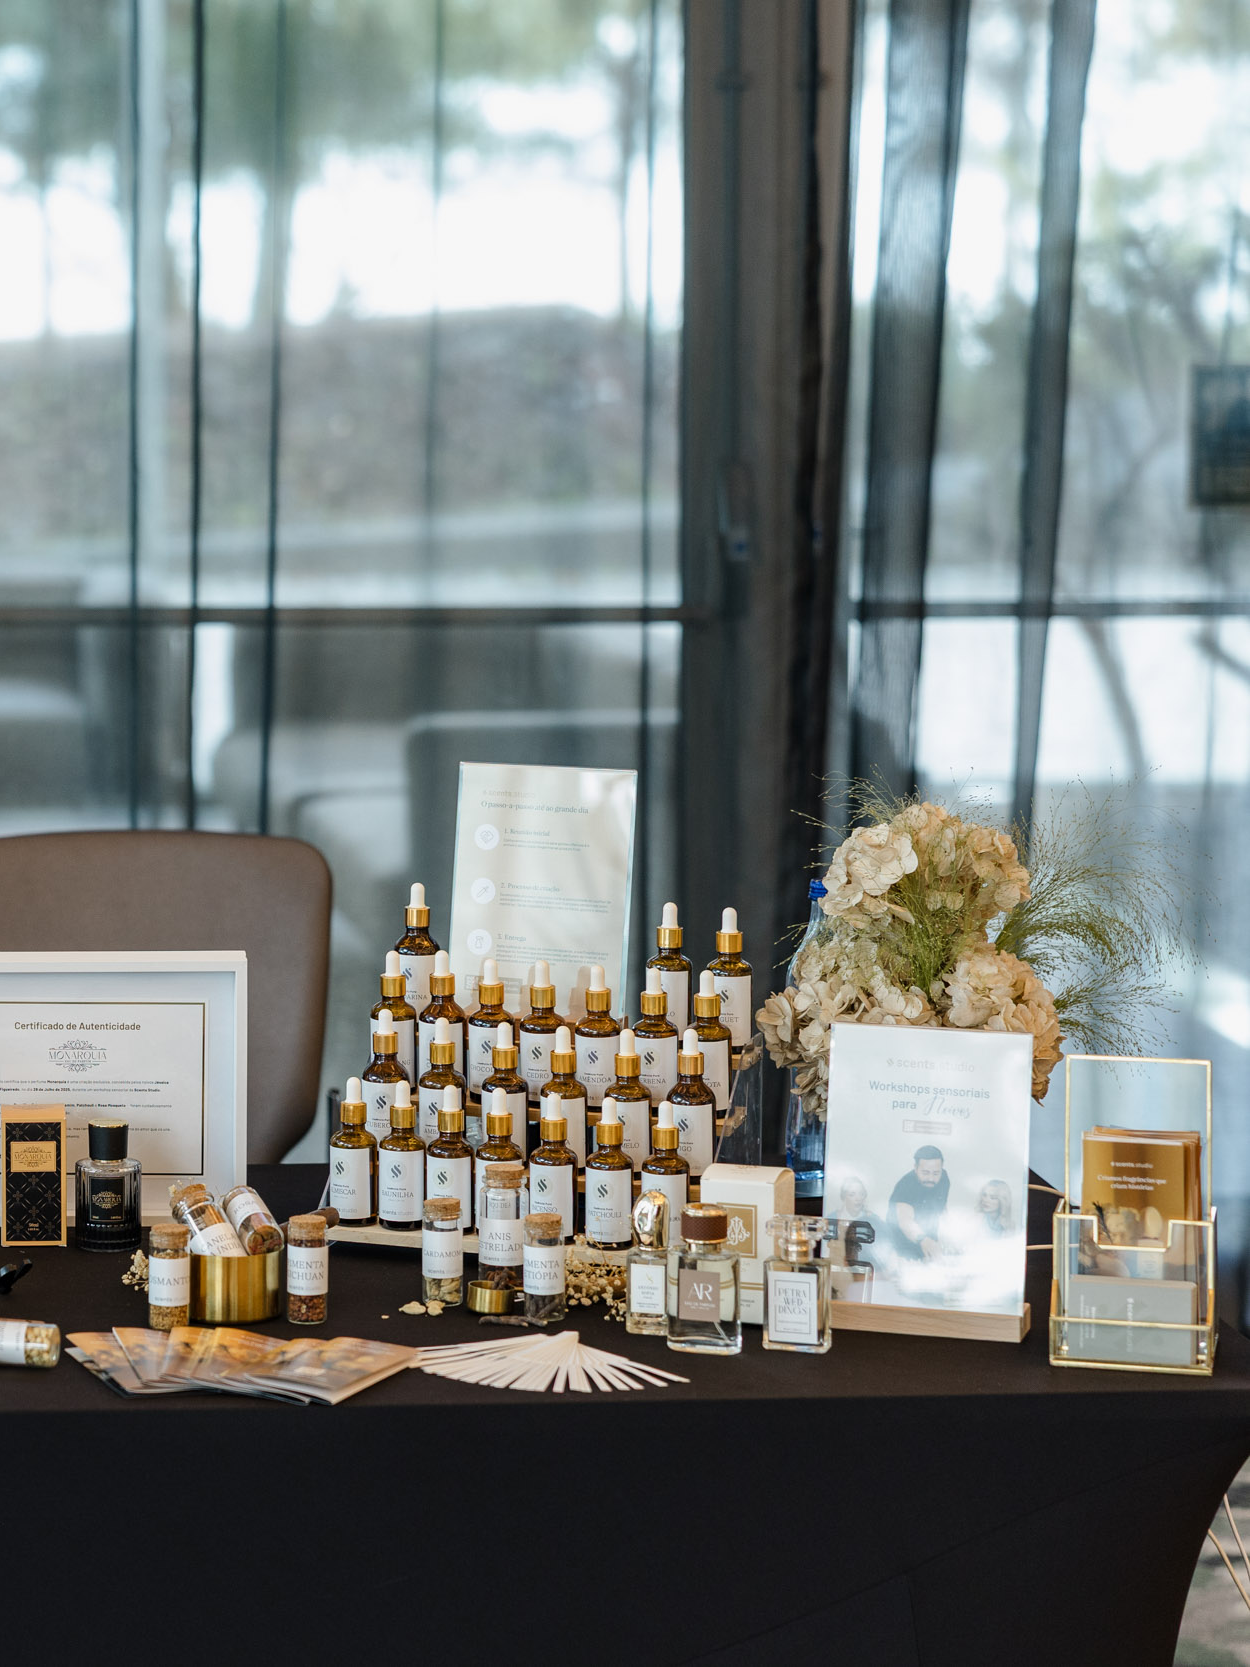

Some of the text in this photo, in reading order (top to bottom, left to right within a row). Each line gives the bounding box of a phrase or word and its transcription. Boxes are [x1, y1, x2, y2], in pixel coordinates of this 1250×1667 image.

[554, 806, 578, 814] grande
[14, 1022, 141, 1031] Certificado de Autenticidade
[48, 1050, 108, 1060] MONARQUIA
[526, 1071, 550, 1079] CEDRO
[869, 1080, 990, 1099] Workshops sensoriais
[892, 1100, 917, 1110] para
[778, 1287, 807, 1298] PETRA
